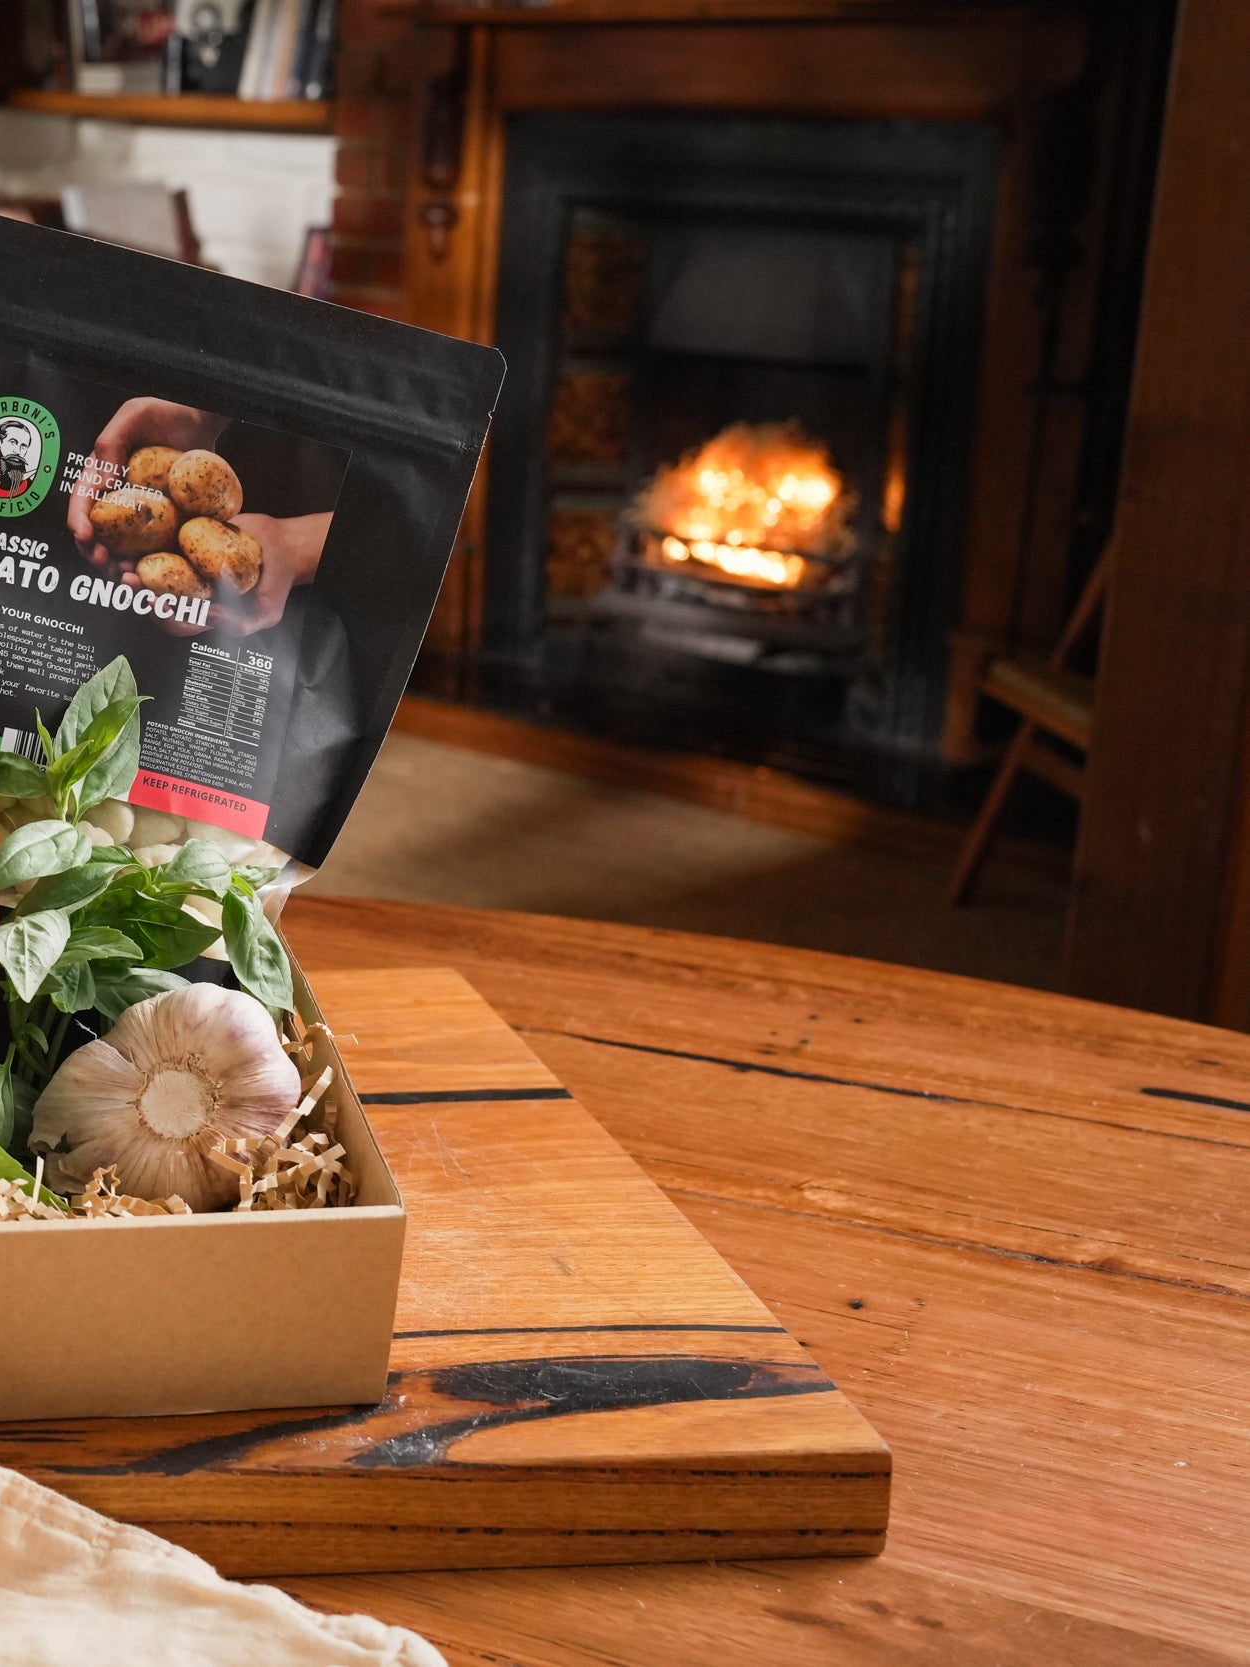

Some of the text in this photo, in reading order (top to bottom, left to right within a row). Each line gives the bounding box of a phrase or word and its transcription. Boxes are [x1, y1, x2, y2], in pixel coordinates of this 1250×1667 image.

[67, 452, 130, 477] PROUDLY
[63, 466, 163, 501] HAND CRAFTED
[59, 480, 145, 512] IN BALLARAT
[69, 575, 211, 627] GNOCCHI
[1, 606, 31, 621] YOUR
[33, 615, 84, 635] GNOCCHI
[21, 629, 44, 639] water
[48, 635, 57, 643] to
[60, 638, 74, 648] the
[77, 643, 95, 653] boil
[191, 642, 231, 659] Calories
[0, 649, 9, 657] 45
[11, 653, 44, 667] seconds
[46, 661, 77, 676] Gnocchi
[31, 650, 53, 660] water
[57, 656, 71, 665] and
[74, 661, 101, 675] gently
[50, 645, 73, 656] table
[75, 653, 94, 662] salt
[248, 655, 272, 669] 360
[6, 660, 25, 671] them
[27, 667, 45, 676] well
[0, 687, 17, 697] hot.
[1, 679, 20, 688] your
[24, 683, 60, 698] favorite
[147, 721, 169, 730] POTATO
[169, 726, 194, 737] GNOCCHI
[143, 776, 247, 812] KEEP REFRIGERATED
